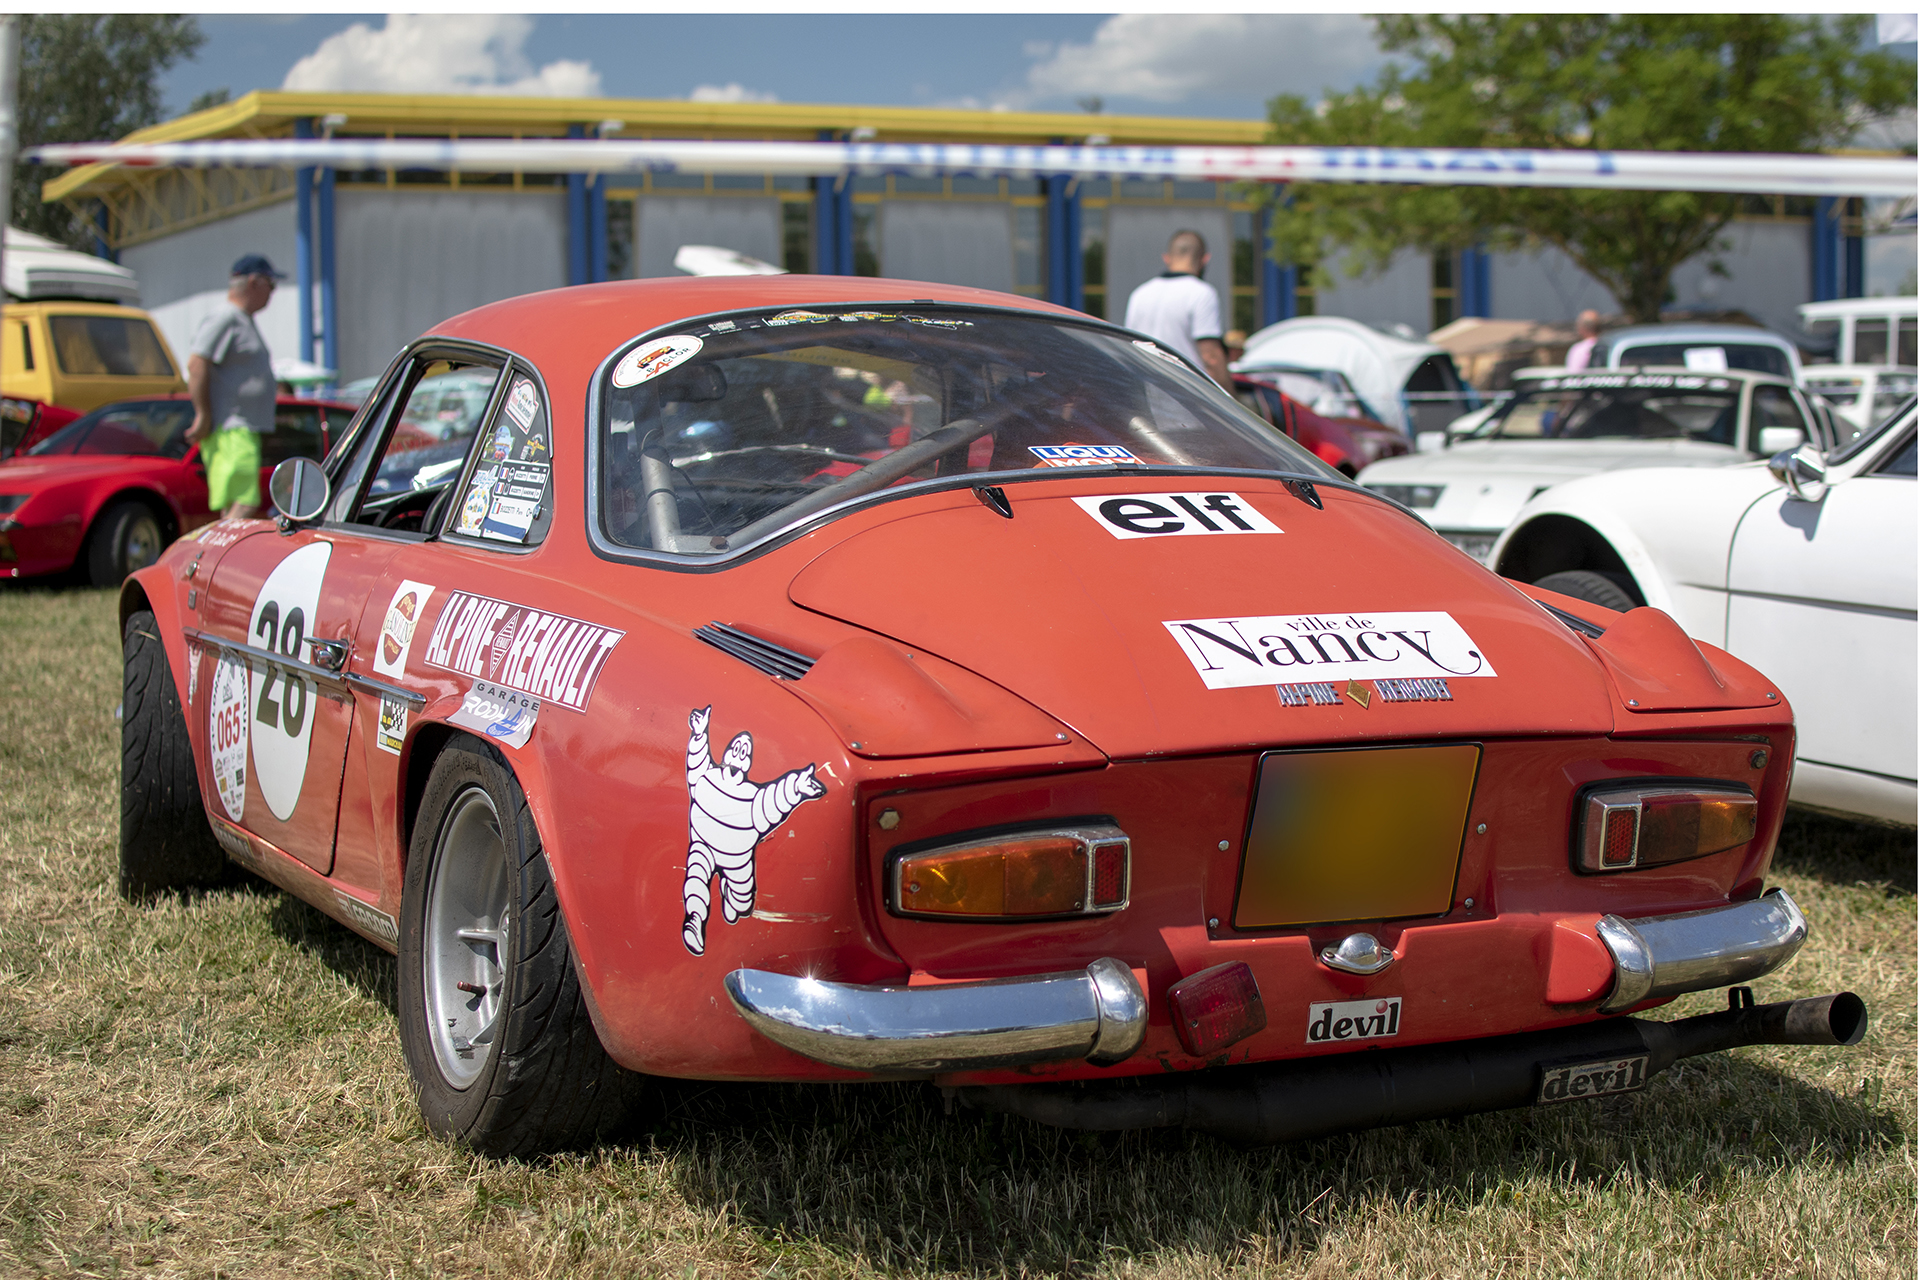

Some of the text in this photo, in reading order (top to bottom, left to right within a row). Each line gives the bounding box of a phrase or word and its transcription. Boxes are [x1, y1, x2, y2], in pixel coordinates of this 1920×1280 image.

[1036, 447, 1127, 459] LIQUI
[1056, 458, 1136, 468] MOLY
[1099, 495, 1256, 534] elf
[1284, 616, 1376, 632] ville de
[426, 593, 622, 707] ALPINE RENAULT
[1170, 620, 1482, 676] Nancy
[256, 600, 307, 738] 28
[477, 682, 540, 712] GARAGE
[1275, 678, 1454, 706] ALPINE RENAULT
[217, 701, 241, 753] 065
[1308, 1000, 1400, 1041] devil
[1543, 1058, 1644, 1100] devil
